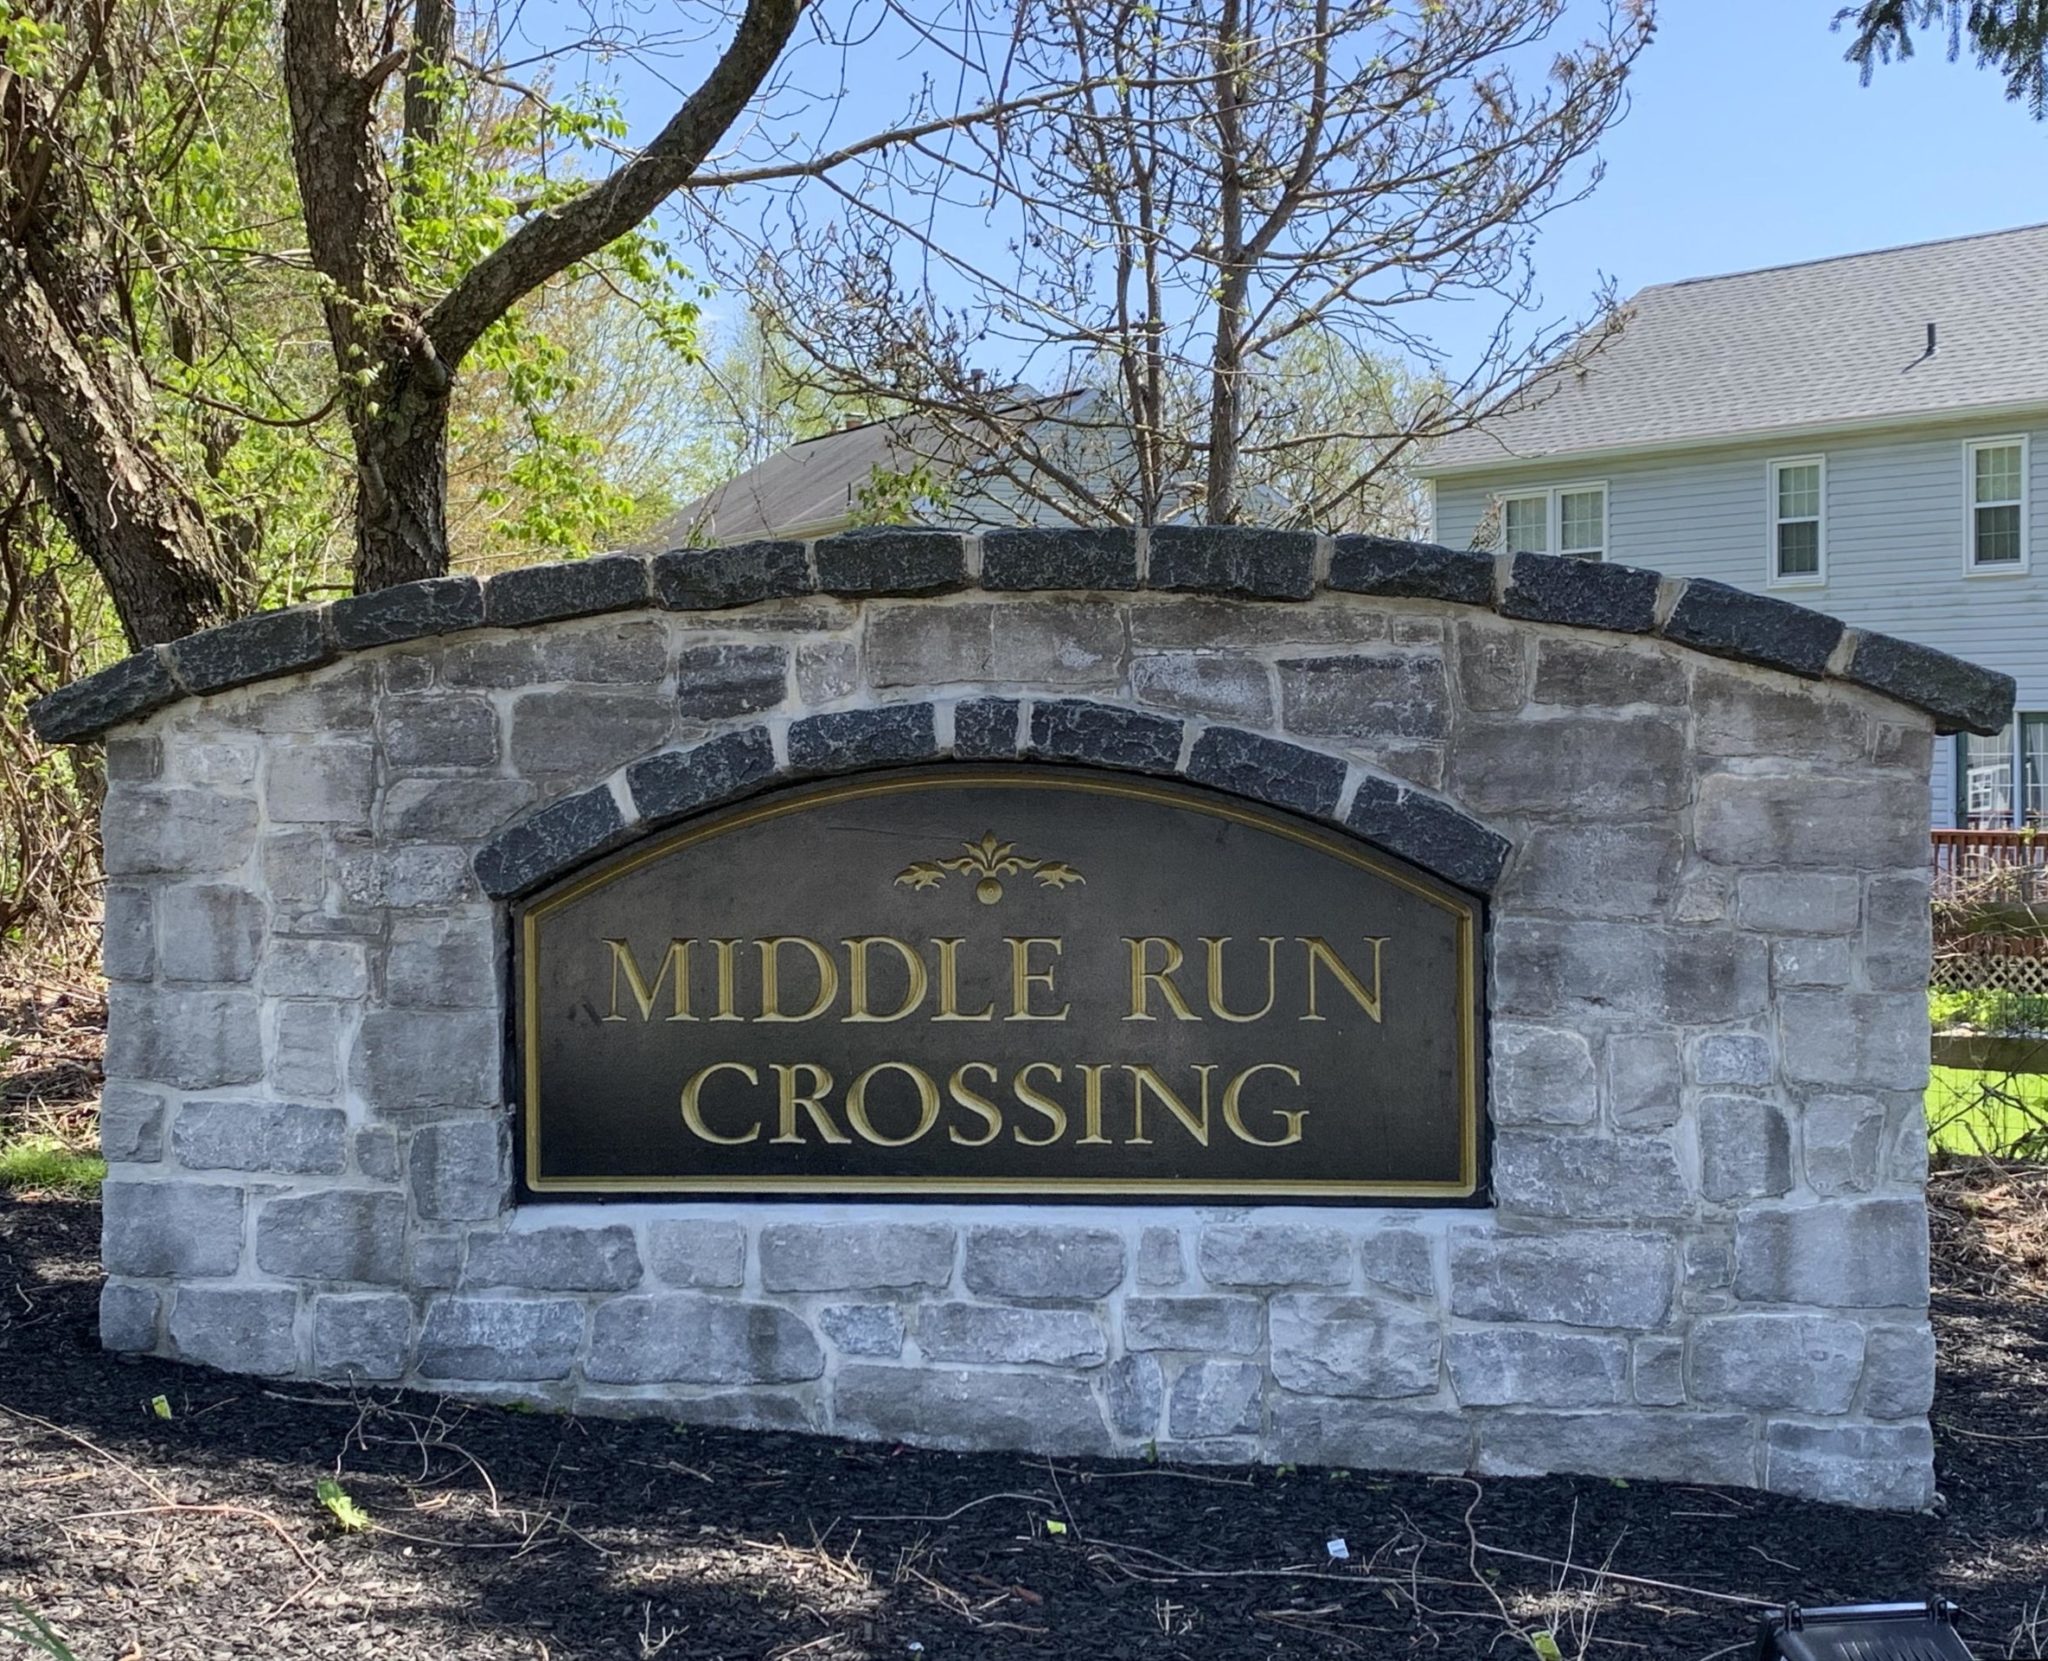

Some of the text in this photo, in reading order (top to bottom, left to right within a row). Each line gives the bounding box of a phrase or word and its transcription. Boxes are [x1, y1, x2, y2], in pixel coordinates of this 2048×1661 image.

[601, 935, 1391, 1024] MIDDLE RUN
[680, 1061, 1310, 1147] CROSSING
